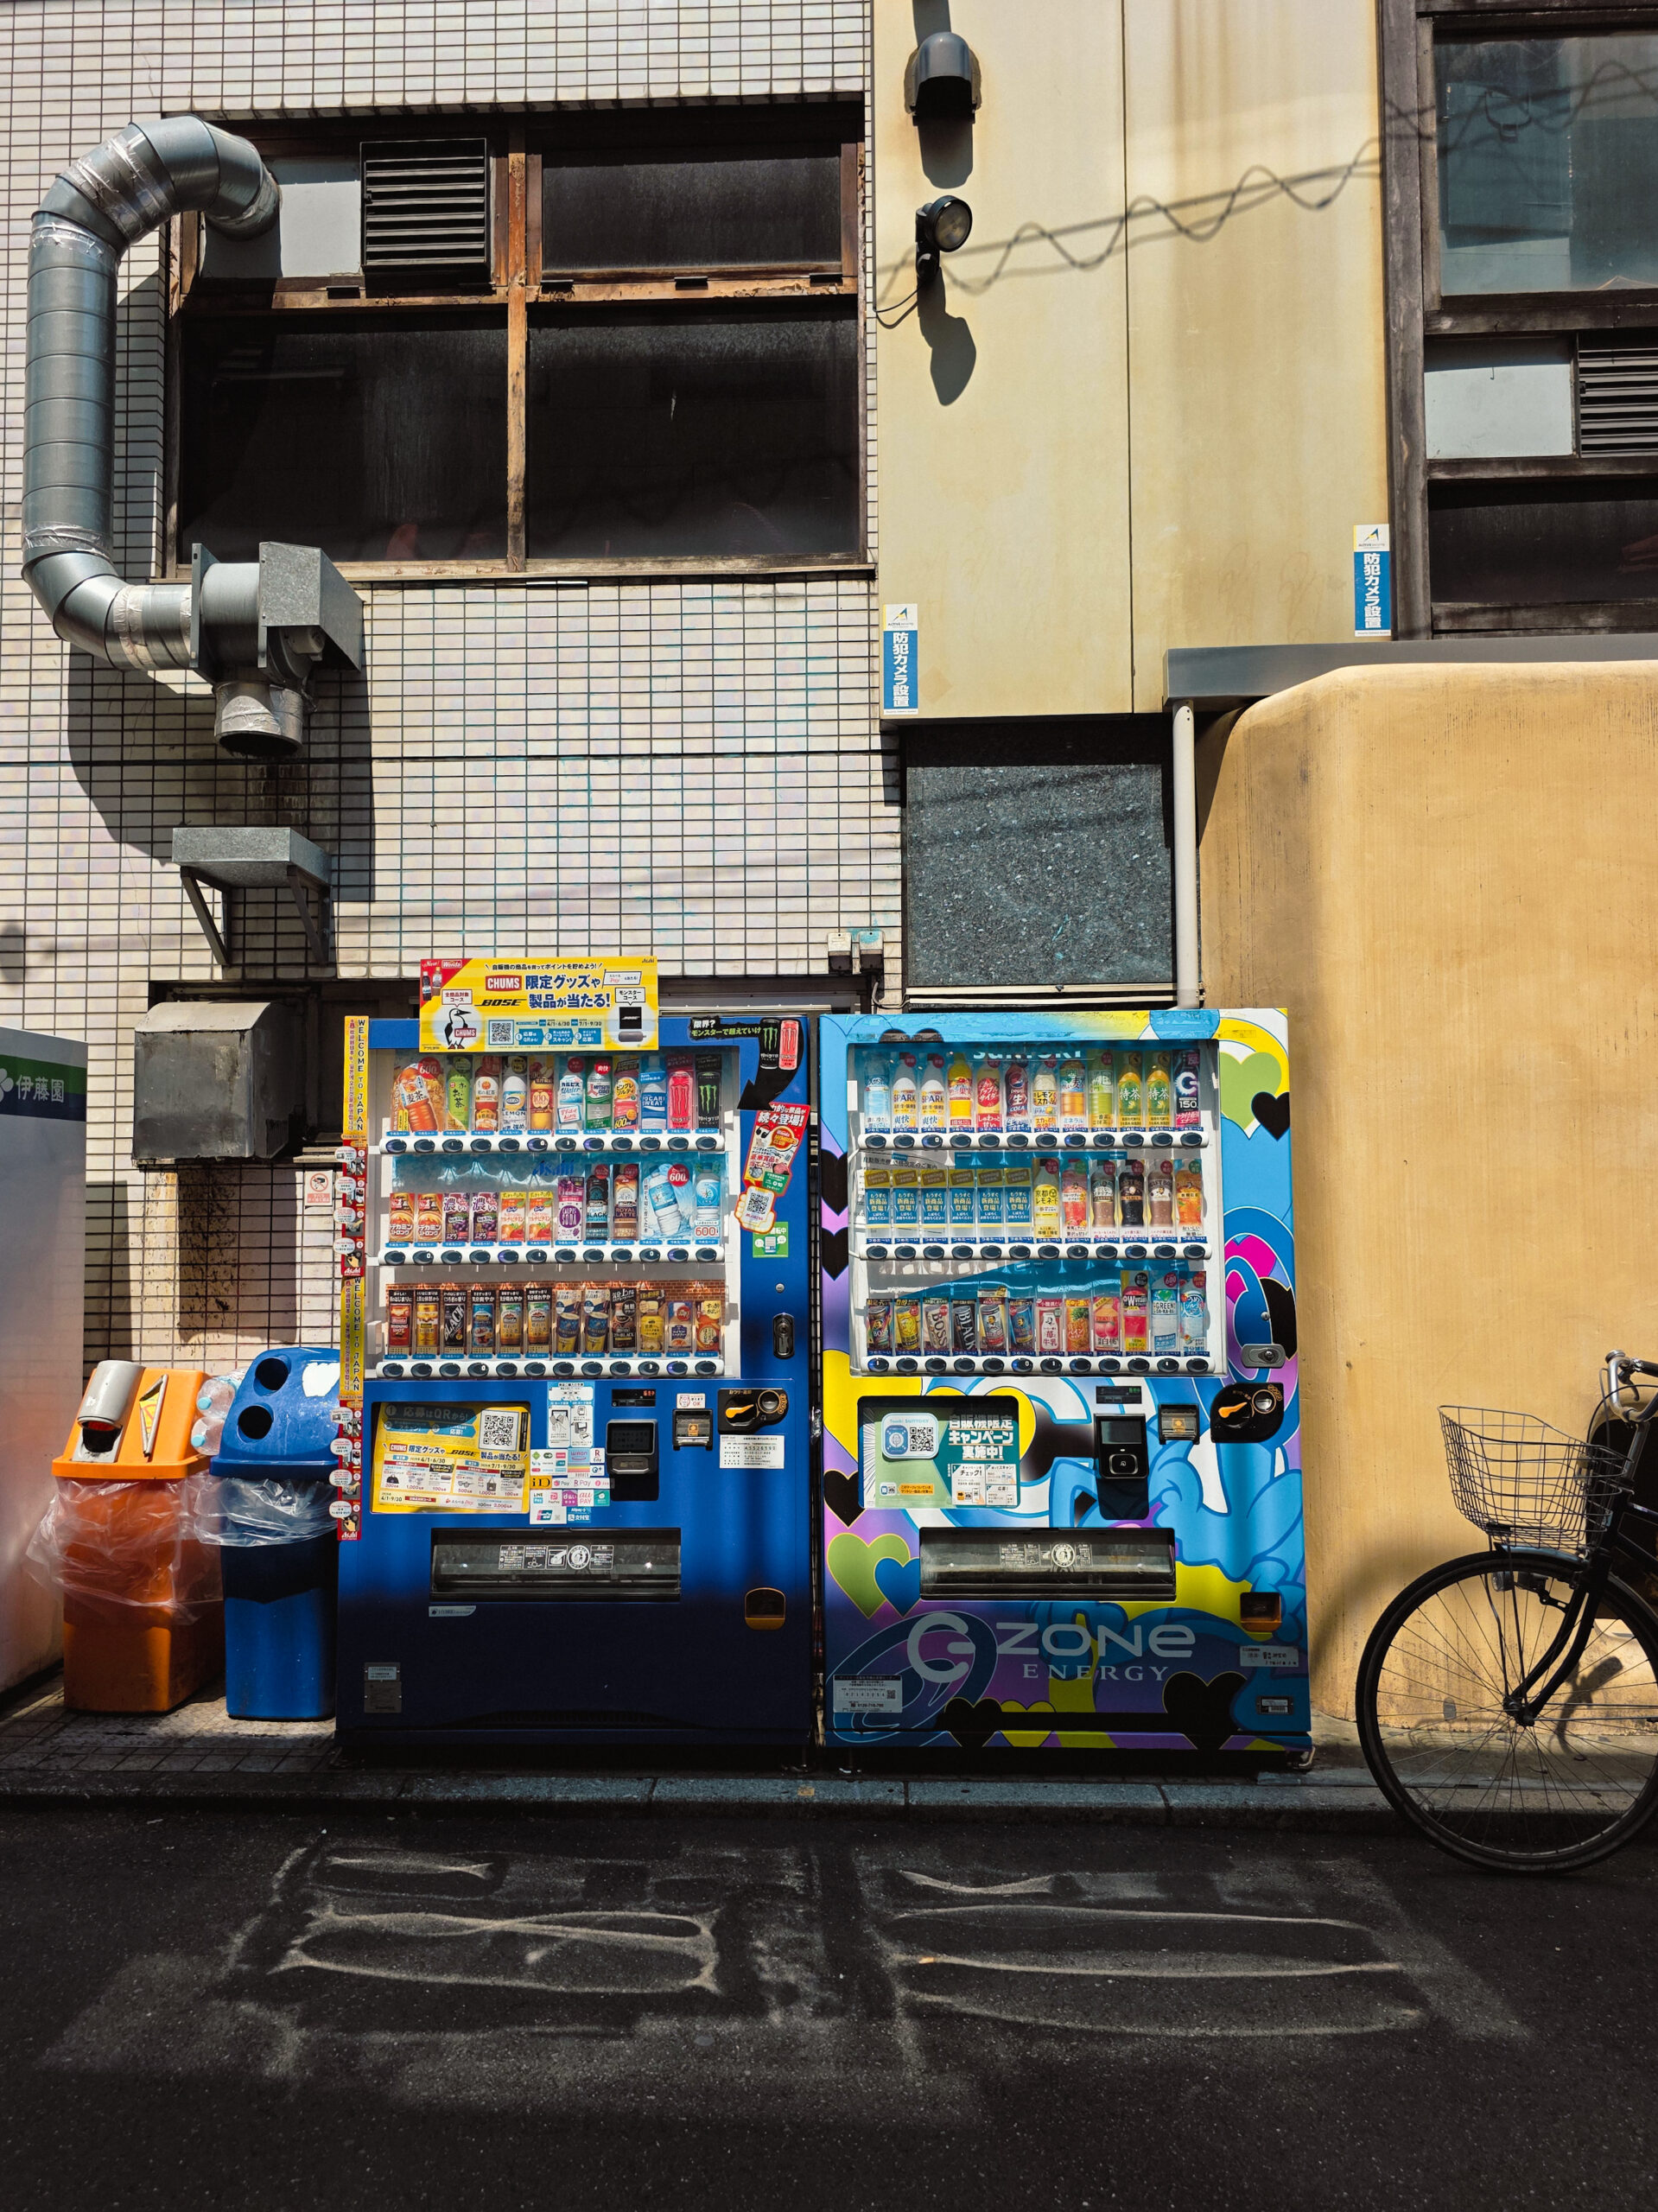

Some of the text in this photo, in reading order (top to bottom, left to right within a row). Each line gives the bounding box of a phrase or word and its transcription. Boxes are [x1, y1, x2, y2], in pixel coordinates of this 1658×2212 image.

[1363, 553, 1382, 629] 防犯カメラ設置
[893, 632, 909, 708] 防犯カメラ設置
[487, 975, 600, 989] CHUMS 限定グッズや
[474, 993, 611, 1008] BOSE 製品が当たる!
[692, 1027, 762, 1037] モンスターで超えていけ
[356, 1020, 365, 1131] WELCOME TO JAPAN
[16, 1074, 65, 1104] 伊藤園
[407, 1090, 424, 1103] 麦茶
[1119, 1087, 1140, 1101] 特茶
[1147, 1087, 1169, 1101] 特茶
[893, 1093, 916, 1103] SPARK
[921, 1094, 944, 1103] SPARK
[757, 1112, 805, 1127] 続々登場!
[562, 1213, 577, 1225] SODA
[444, 1305, 465, 1342] BLACK
[931, 1313, 948, 1346] BOSS
[959, 1307, 976, 1350] BLACK
[354, 1336, 359, 1349] TO
[949, 1414, 1013, 1430] 自販機限定
[949, 1430, 1013, 1445] キャンペーン
[962, 1446, 1004, 1459] 実施中!
[532, 1478, 550, 1487] iD
[996, 1622, 1196, 1658] ZONe
[1023, 1663, 1169, 1682] ENERGY
